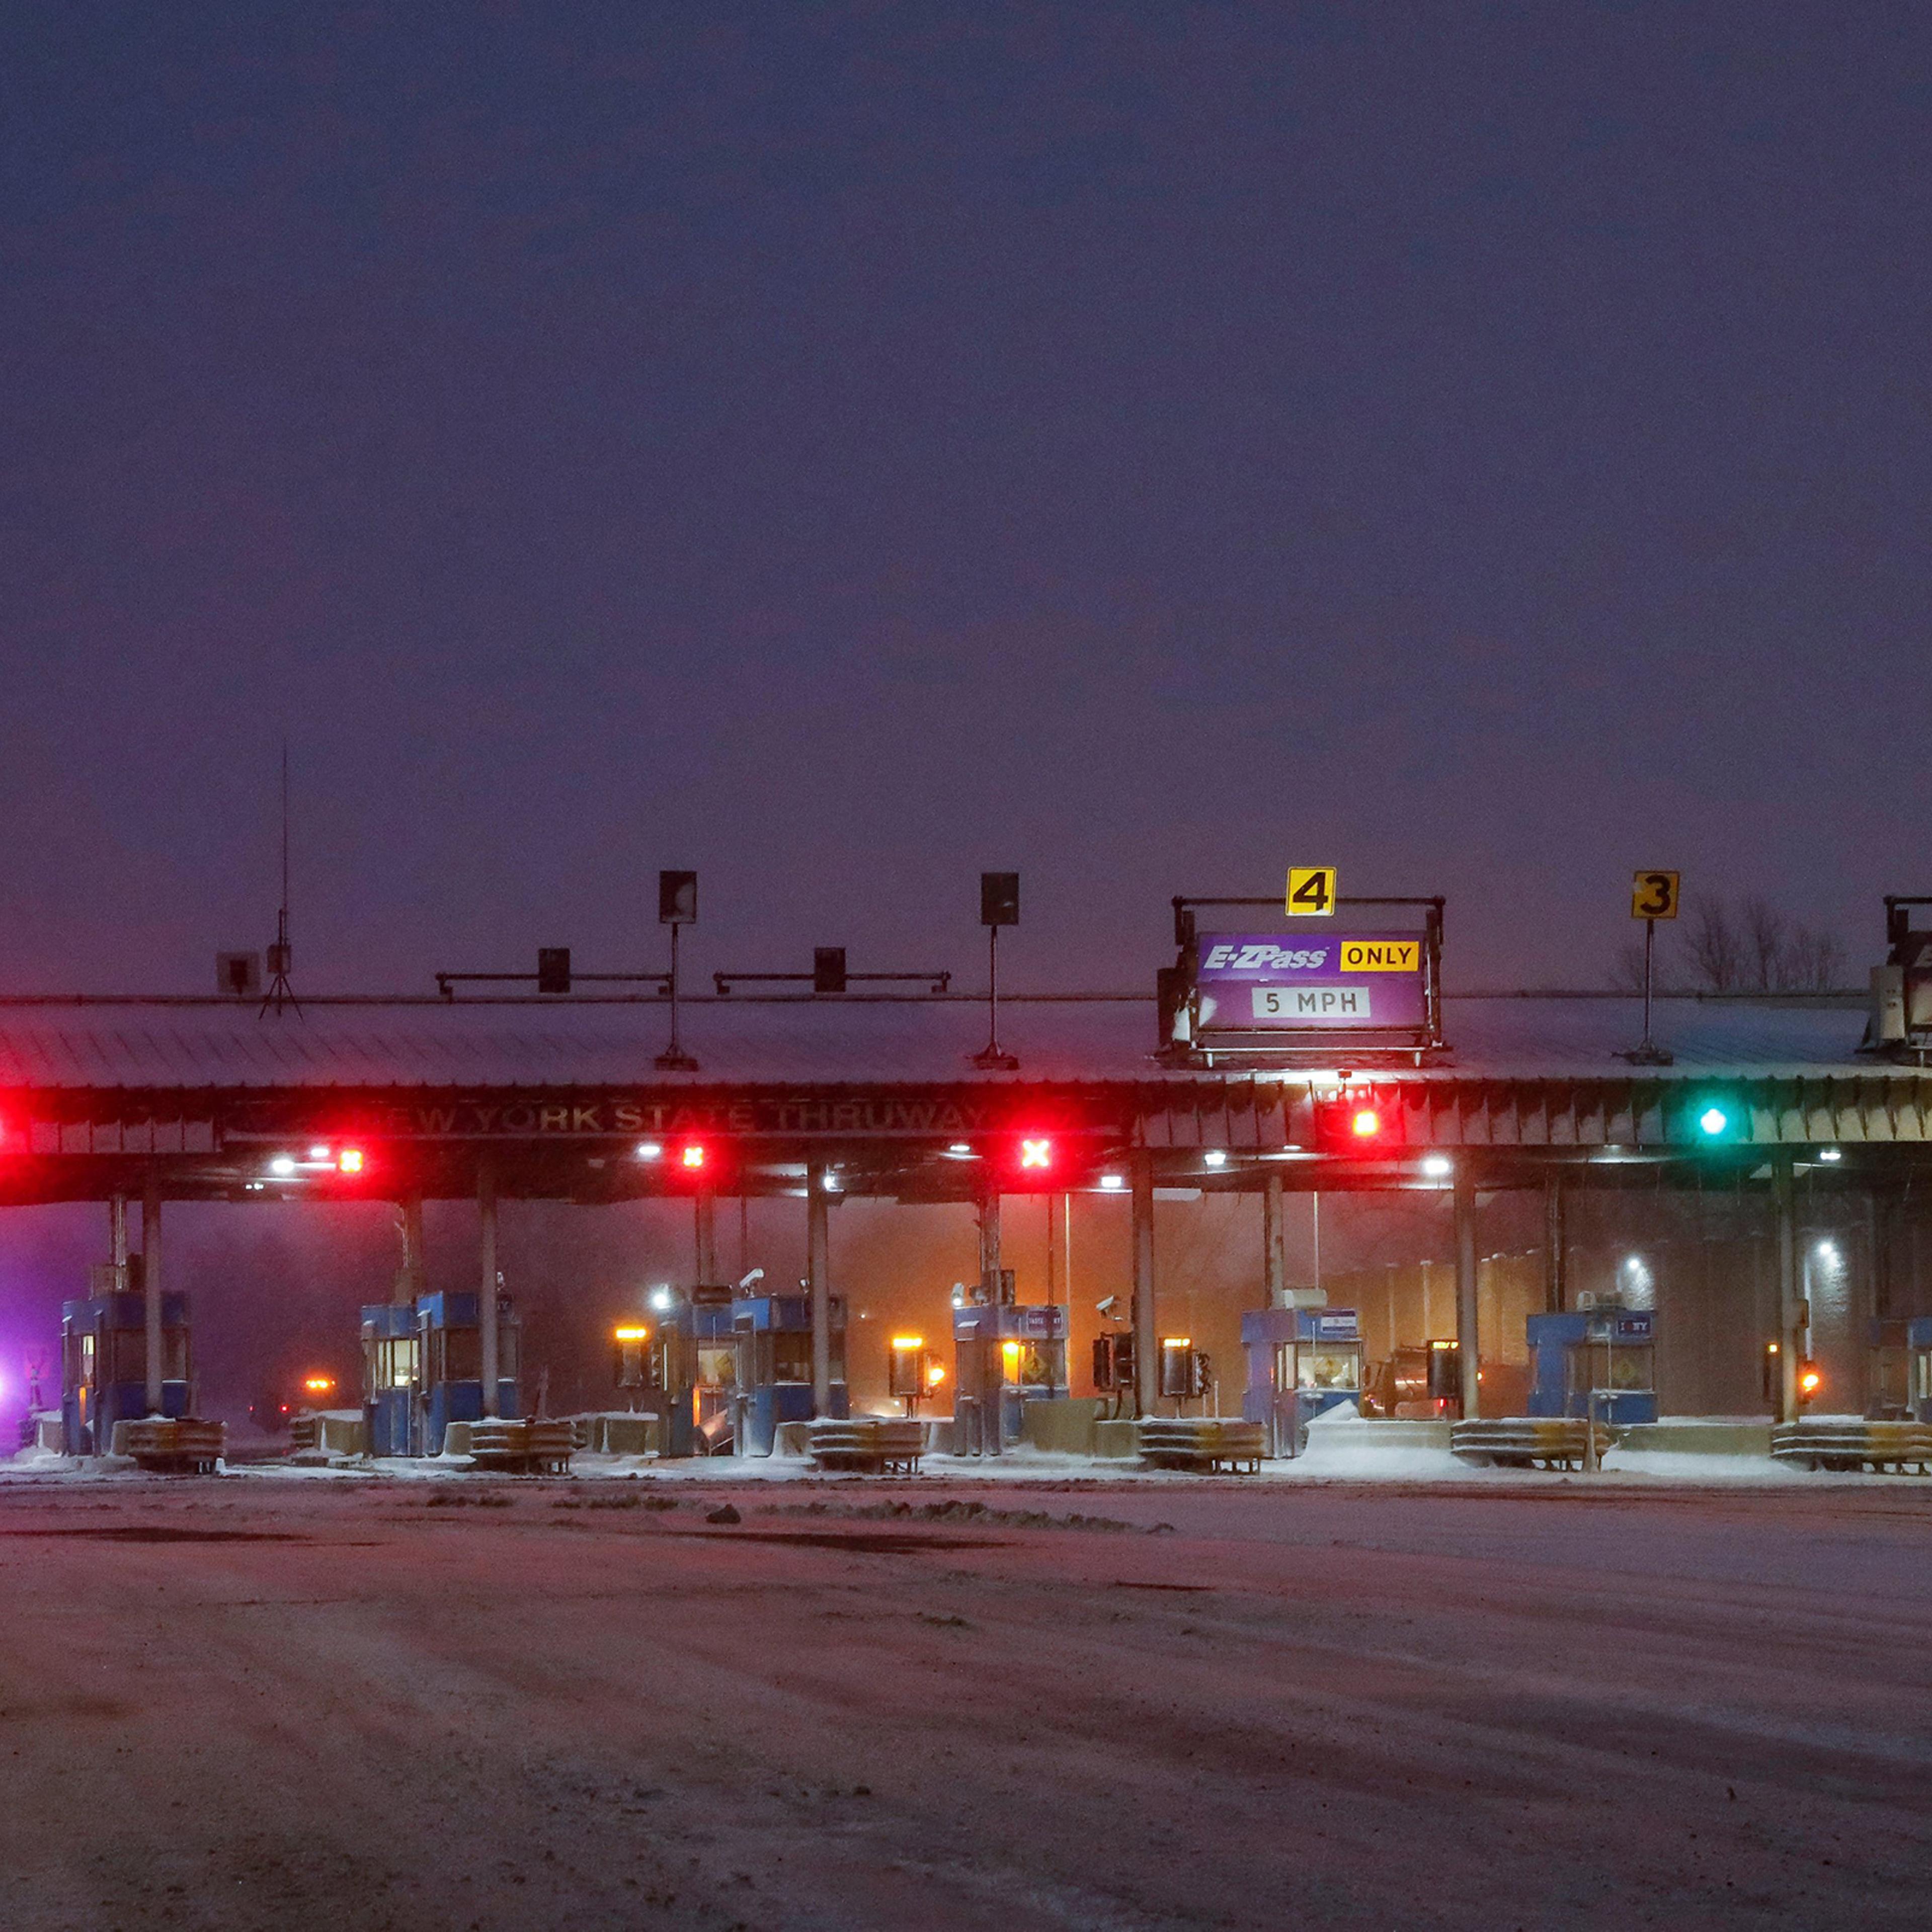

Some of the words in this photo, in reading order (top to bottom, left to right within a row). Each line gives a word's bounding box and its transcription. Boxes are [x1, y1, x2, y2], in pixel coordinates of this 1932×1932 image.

[1293, 872, 1328, 911] 4
[1640, 875, 1670, 914] 3
[1203, 945, 1327, 969] E-ZPass
[1347, 947, 1412, 964] ONLY
[1266, 993, 1279, 1012] 5
[1298, 993, 1356, 1012] MPH
[473, 1105, 603, 1132] YORK
[614, 1105, 754, 1131] STATE
[775, 1104, 989, 1130] THRUWAY
